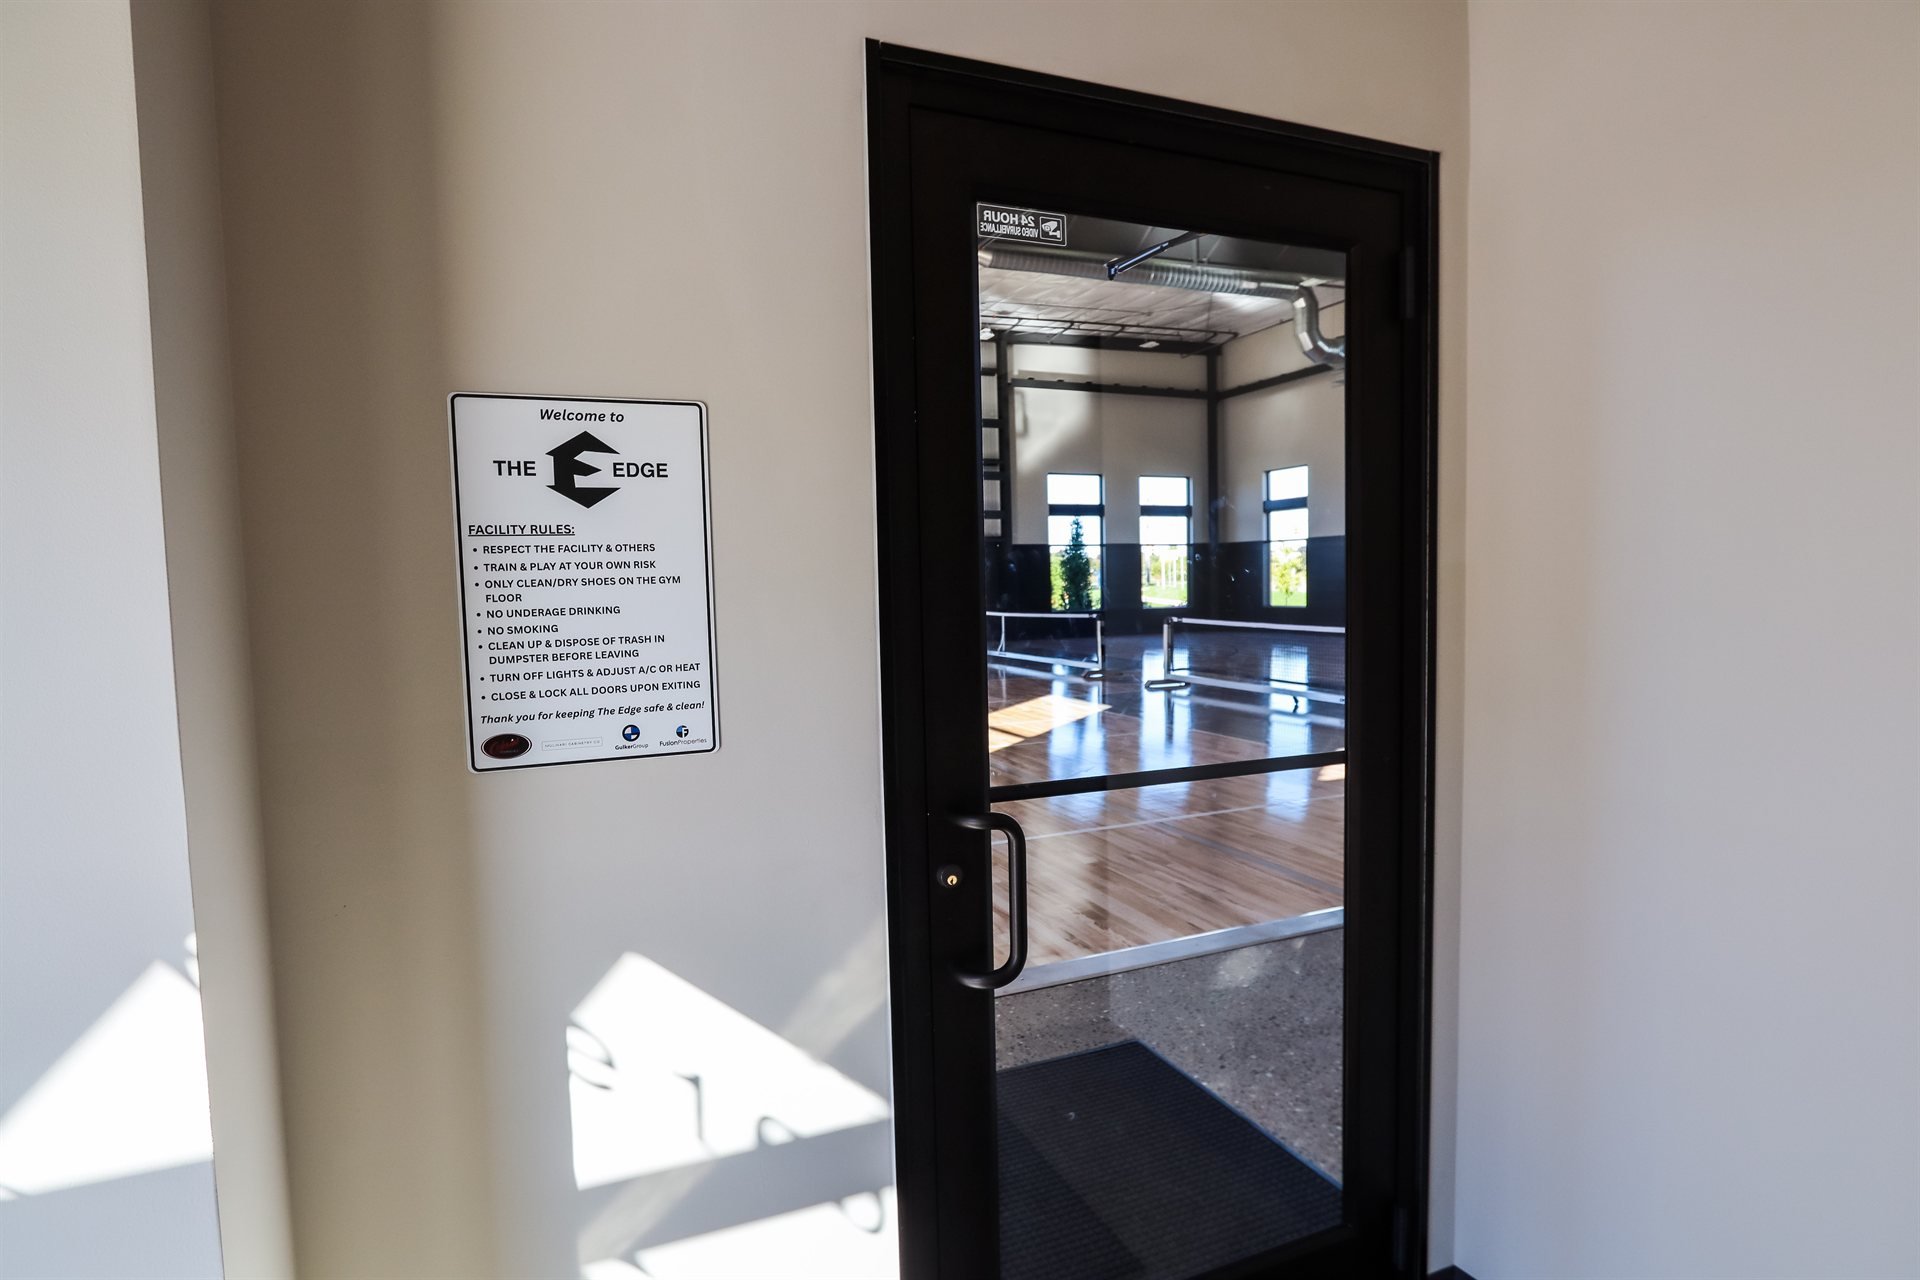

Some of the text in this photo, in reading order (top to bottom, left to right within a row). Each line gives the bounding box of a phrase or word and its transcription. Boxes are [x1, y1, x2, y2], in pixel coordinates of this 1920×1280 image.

[540, 409, 624, 423] Welcome to
[493, 460, 668, 478] THE EDGE
[468, 524, 575, 535] FACILITY RULES:
[483, 543, 655, 554] RESPECT THE FACILITY & OTHERS
[483, 560, 656, 572] TRAIN & PLAY AT YOUR OWN RISK
[484, 575, 681, 589] ONLY CLEAN/DRY SHOES ON THE GYM
[486, 593, 522, 603] FLOOR
[486, 606, 621, 619] NO UNDERAGE DRINKING
[487, 624, 559, 635] NO SMOKING
[488, 634, 665, 651] CLEAN UP & DISPOSE OF TRASH IN
[489, 649, 639, 665] DUMPSTER BEFORE LEAVING
[490, 662, 701, 683] TURN OFF LIGHTS & ADJUST A/C OR HEAT
[491, 680, 701, 702] CLOSE & LOCK ALL DOORS UPON EXITING
[481, 701, 705, 725] Thank you for keeping The Edge safe & clean!
